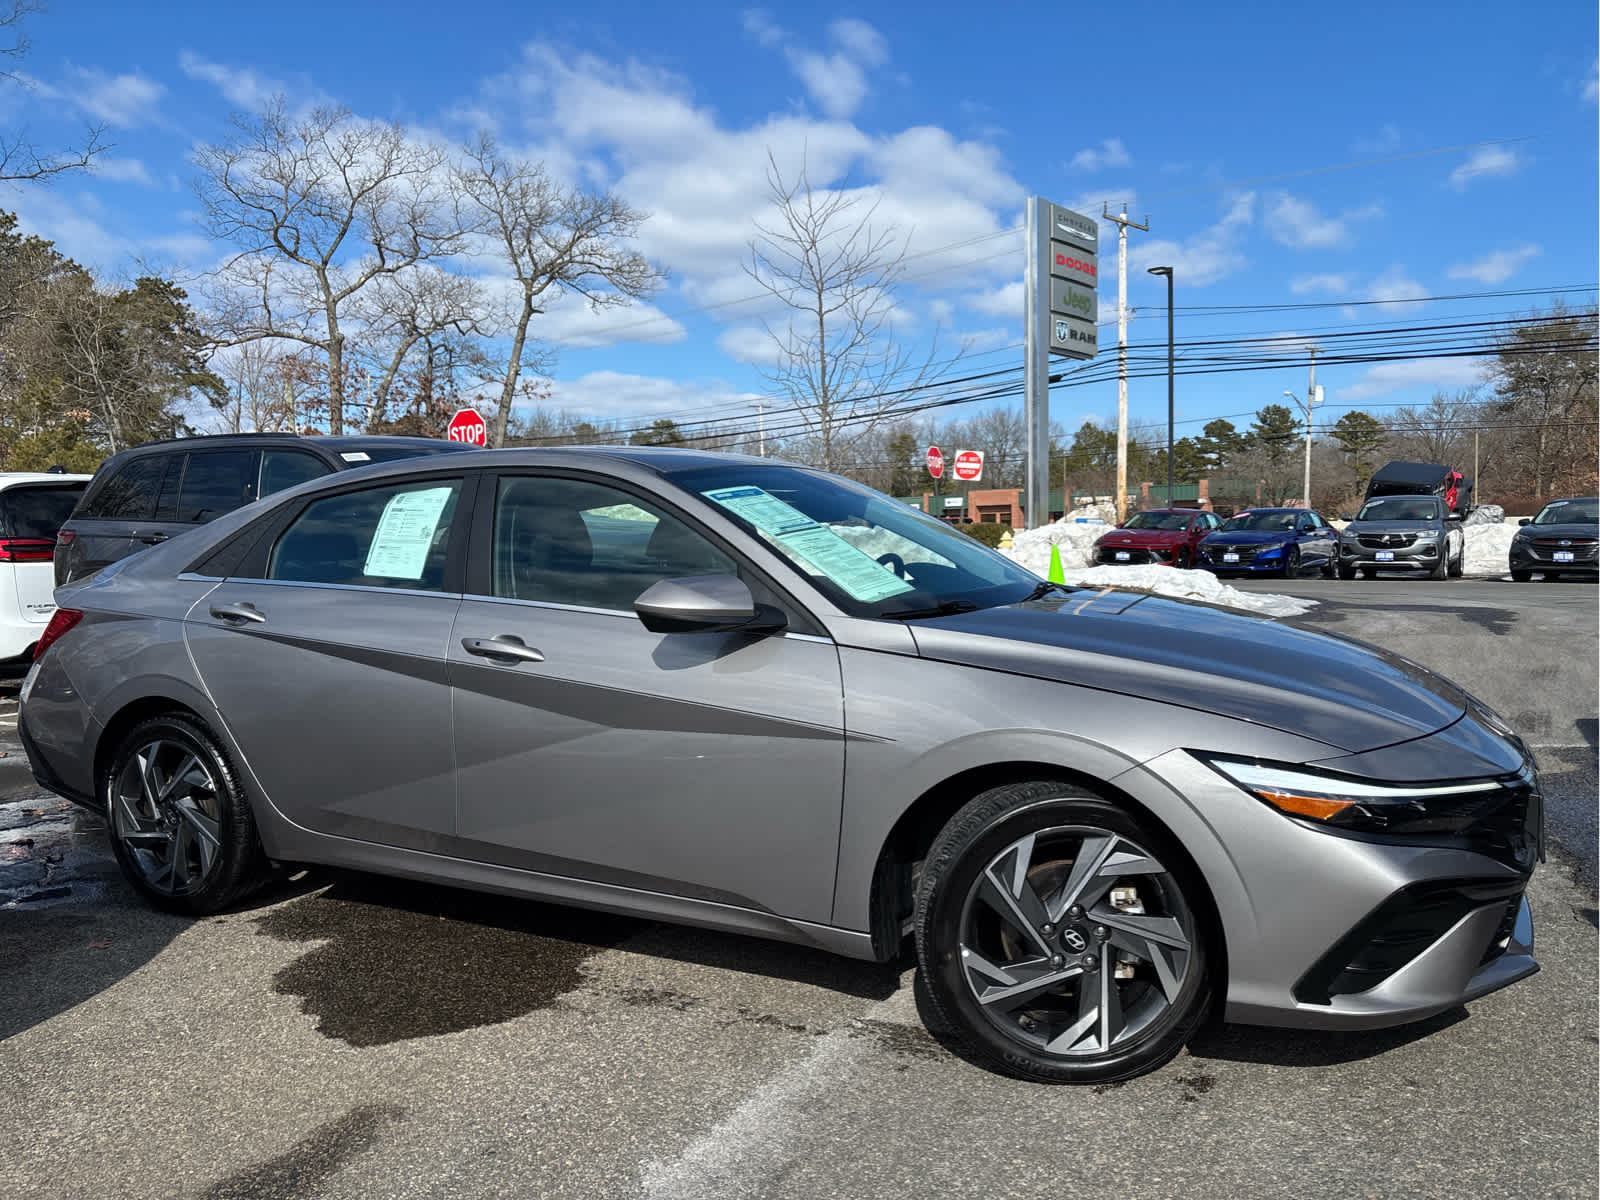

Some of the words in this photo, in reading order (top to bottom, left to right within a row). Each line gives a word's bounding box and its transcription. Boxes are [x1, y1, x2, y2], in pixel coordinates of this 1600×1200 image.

[1055, 254, 1096, 276] DODGE
[1063, 287, 1091, 312] Jeep
[1070, 329, 1096, 344] RAM
[451, 424, 483, 443] STOP
